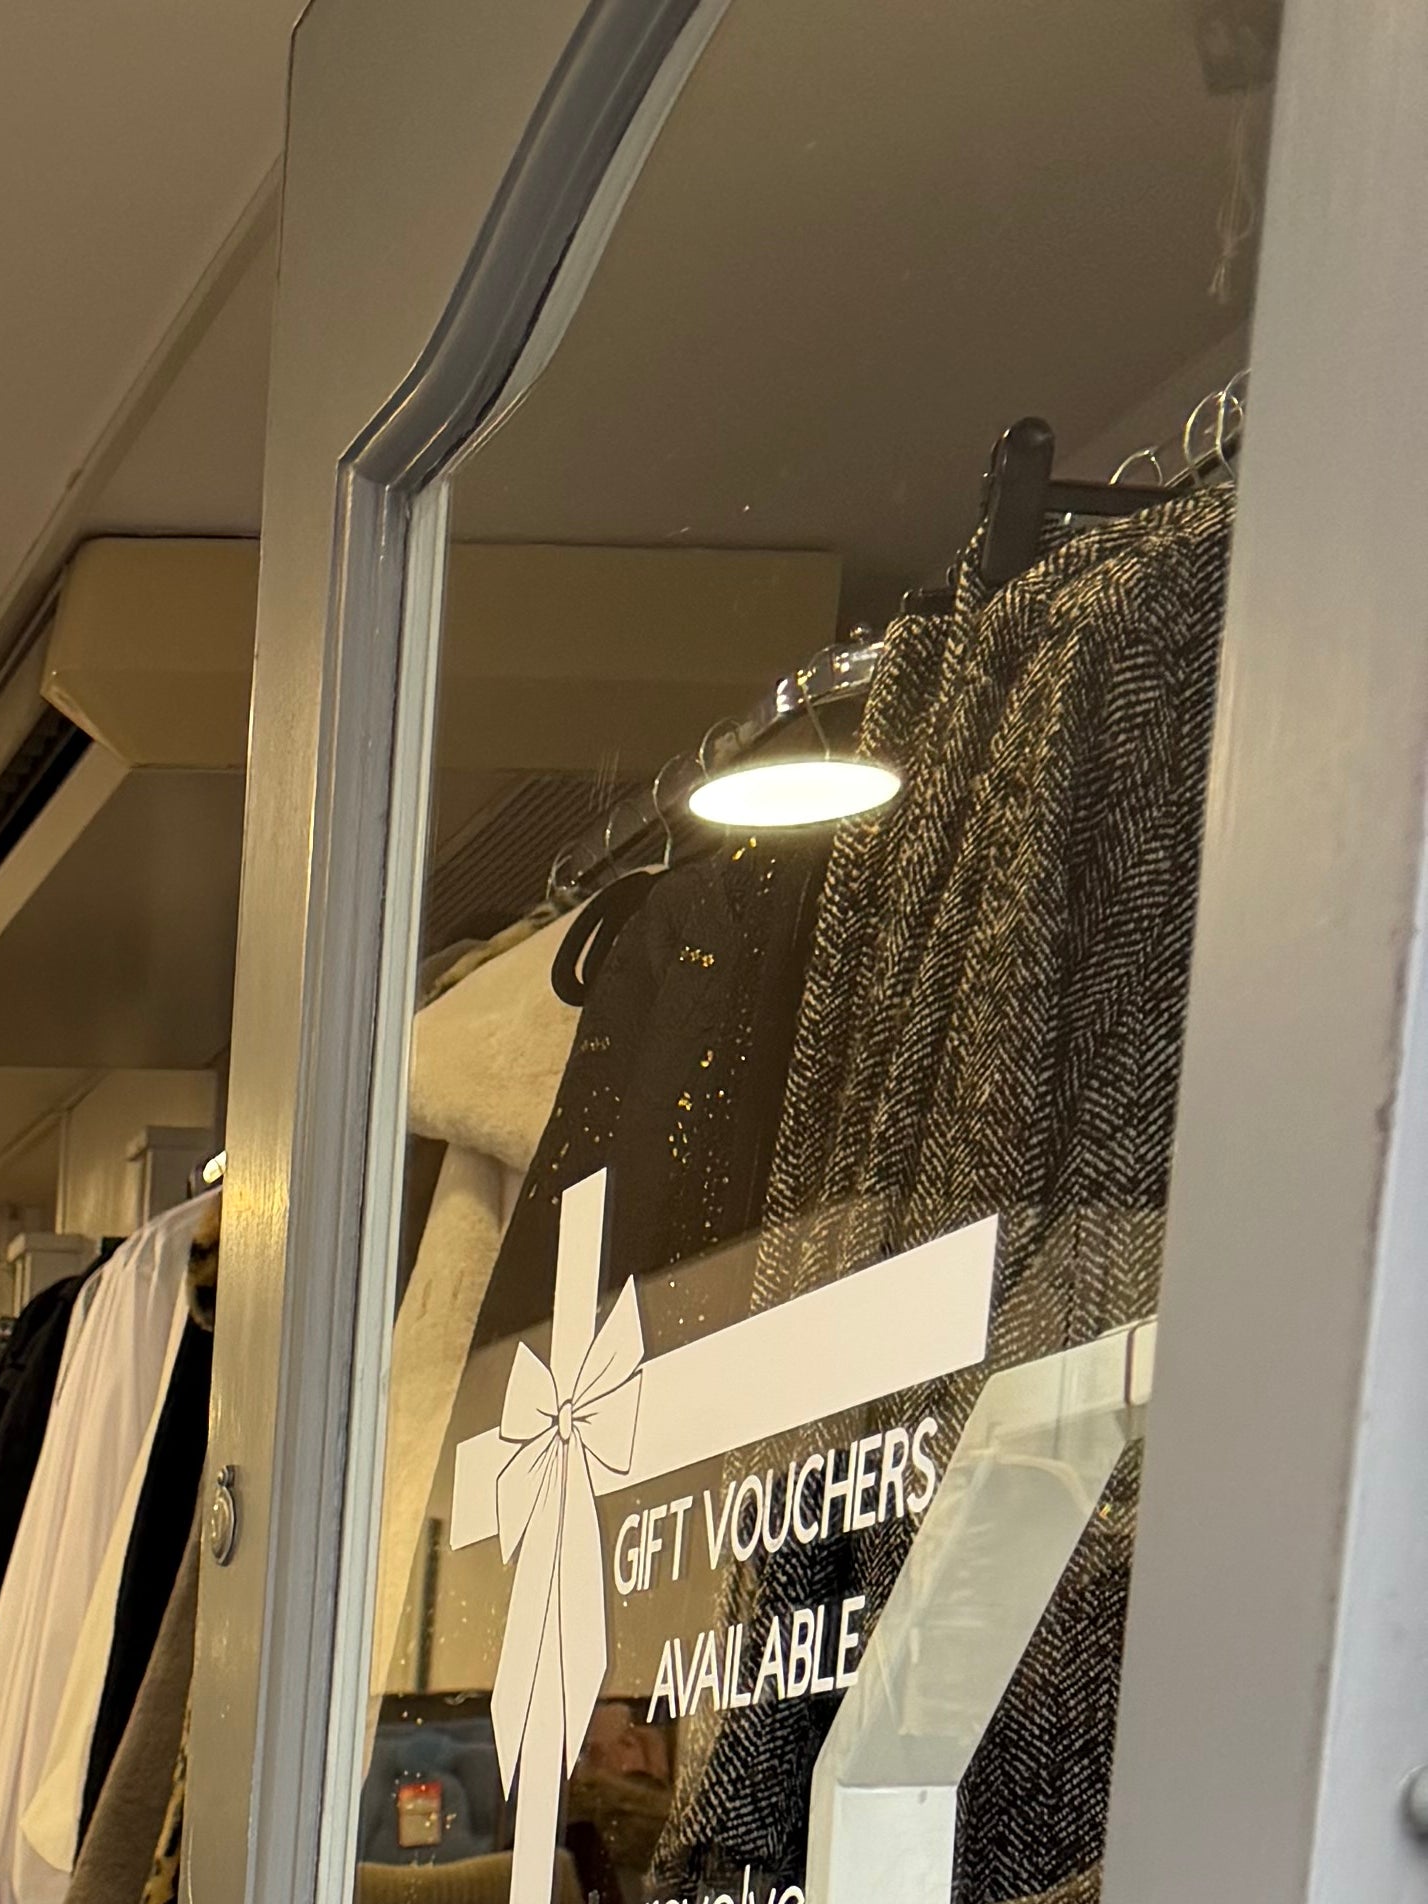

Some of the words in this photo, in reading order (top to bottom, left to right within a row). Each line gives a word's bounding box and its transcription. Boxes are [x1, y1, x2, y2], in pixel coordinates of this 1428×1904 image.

[612, 1494, 694, 1596] GIFT
[703, 1416, 939, 1571] VOUCHERS
[645, 1594, 866, 1724] AVAILABLE
